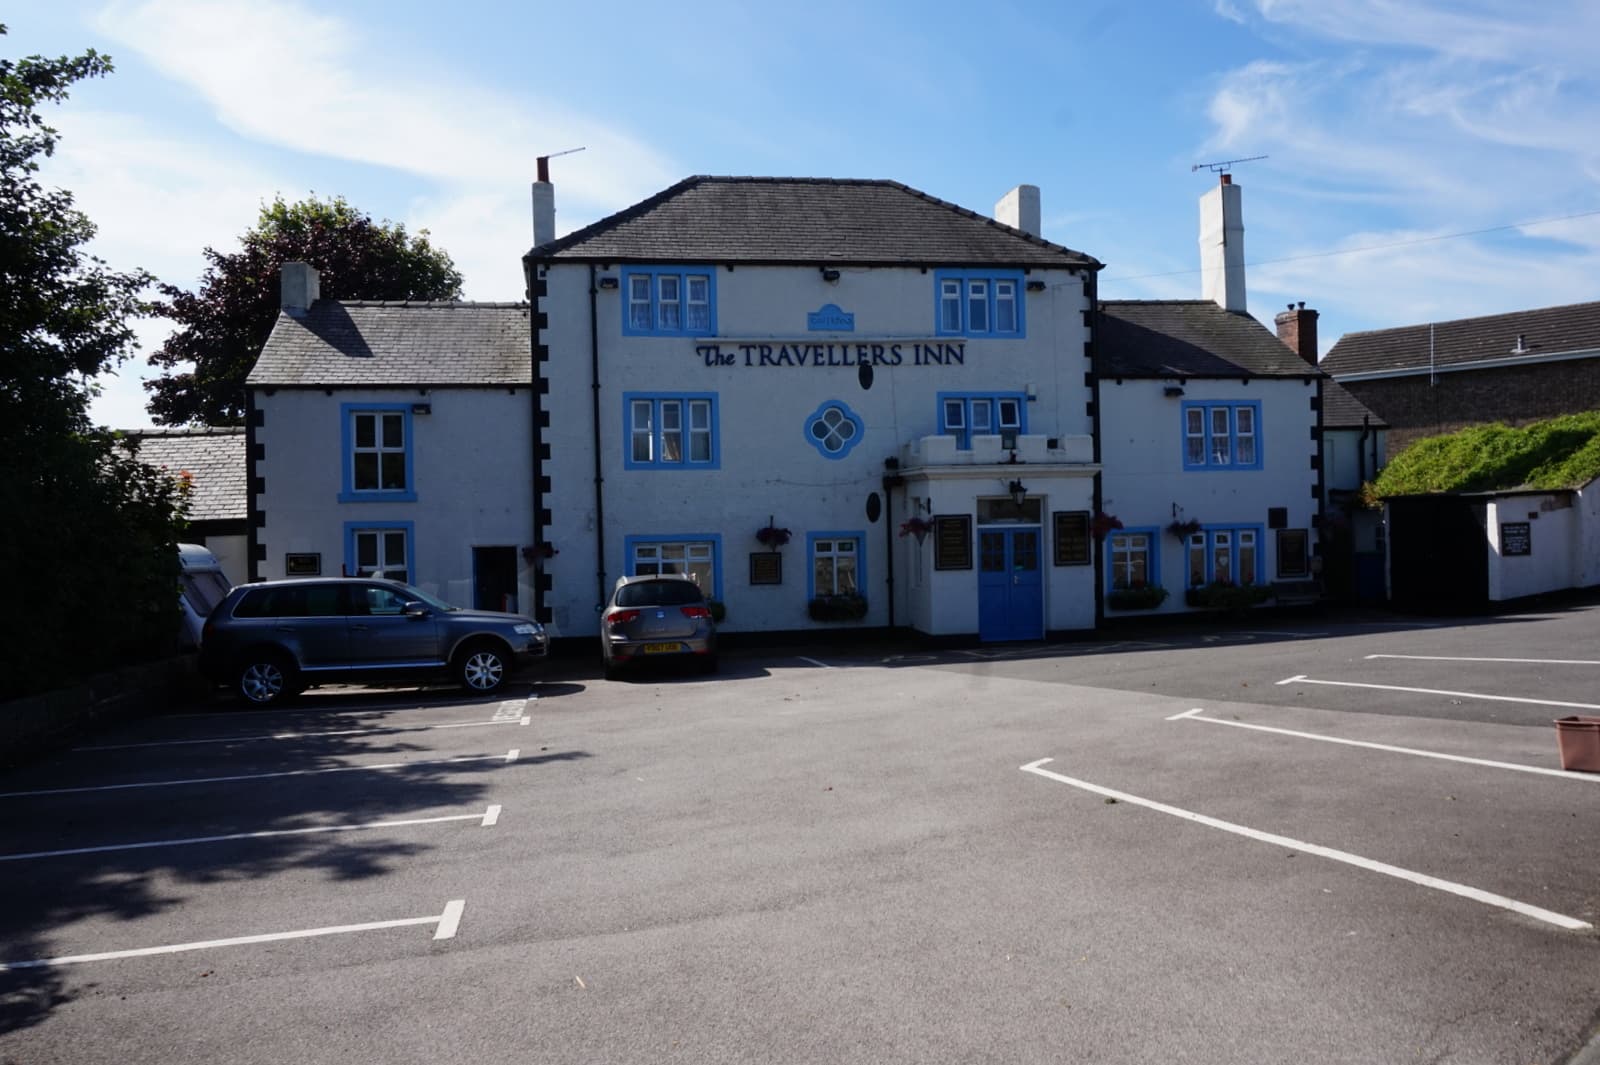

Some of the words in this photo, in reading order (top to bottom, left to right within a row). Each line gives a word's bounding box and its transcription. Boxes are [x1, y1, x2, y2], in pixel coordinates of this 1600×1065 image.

[696, 344, 736, 367] The
[738, 344, 903, 367] TRAVELLERS
[913, 343, 966, 366] INN
